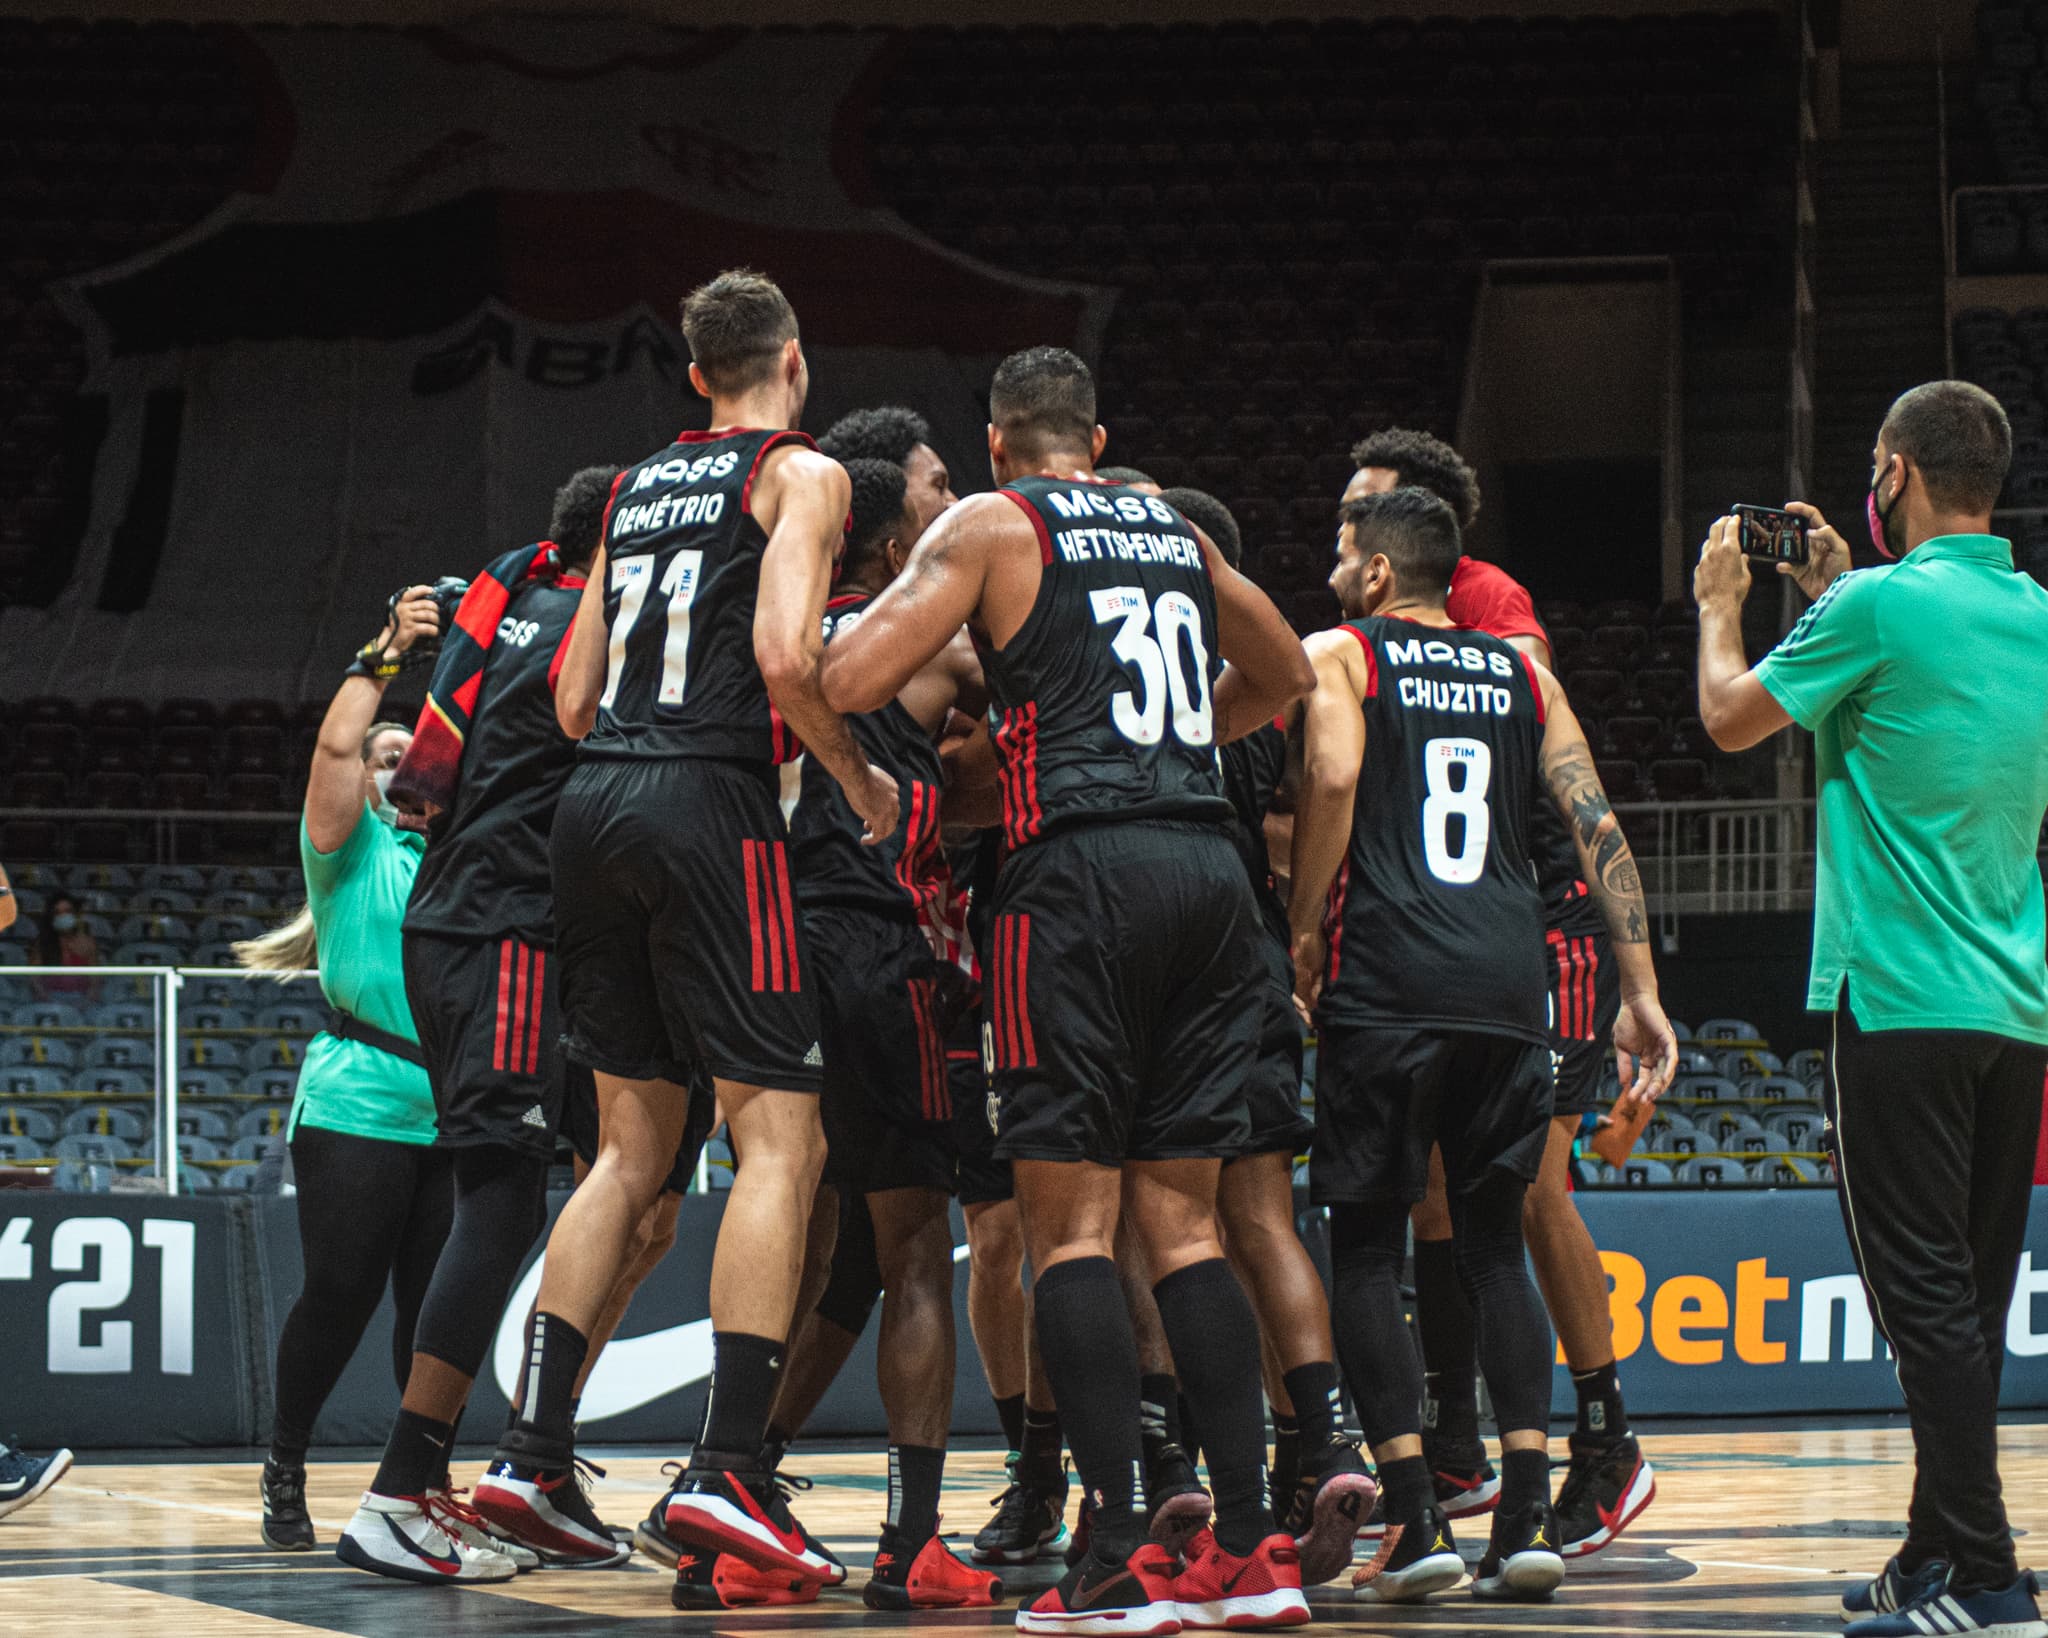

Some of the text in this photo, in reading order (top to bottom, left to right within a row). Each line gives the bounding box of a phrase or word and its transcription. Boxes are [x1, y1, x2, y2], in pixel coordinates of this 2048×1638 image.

[612, 492, 725, 538] DEMÉTRIO
[626, 564, 642, 576] TIM
[681, 568, 693, 592] TIM
[1120, 596, 1139, 608] TIM
[1177, 603, 1191, 618] TIM
[599, 549, 704, 709] 71
[1088, 586, 1214, 746] 30
[1398, 676, 1512, 716] CHUZITO
[1453, 747, 1475, 758] TIM
[1422, 737, 1492, 884] 8
